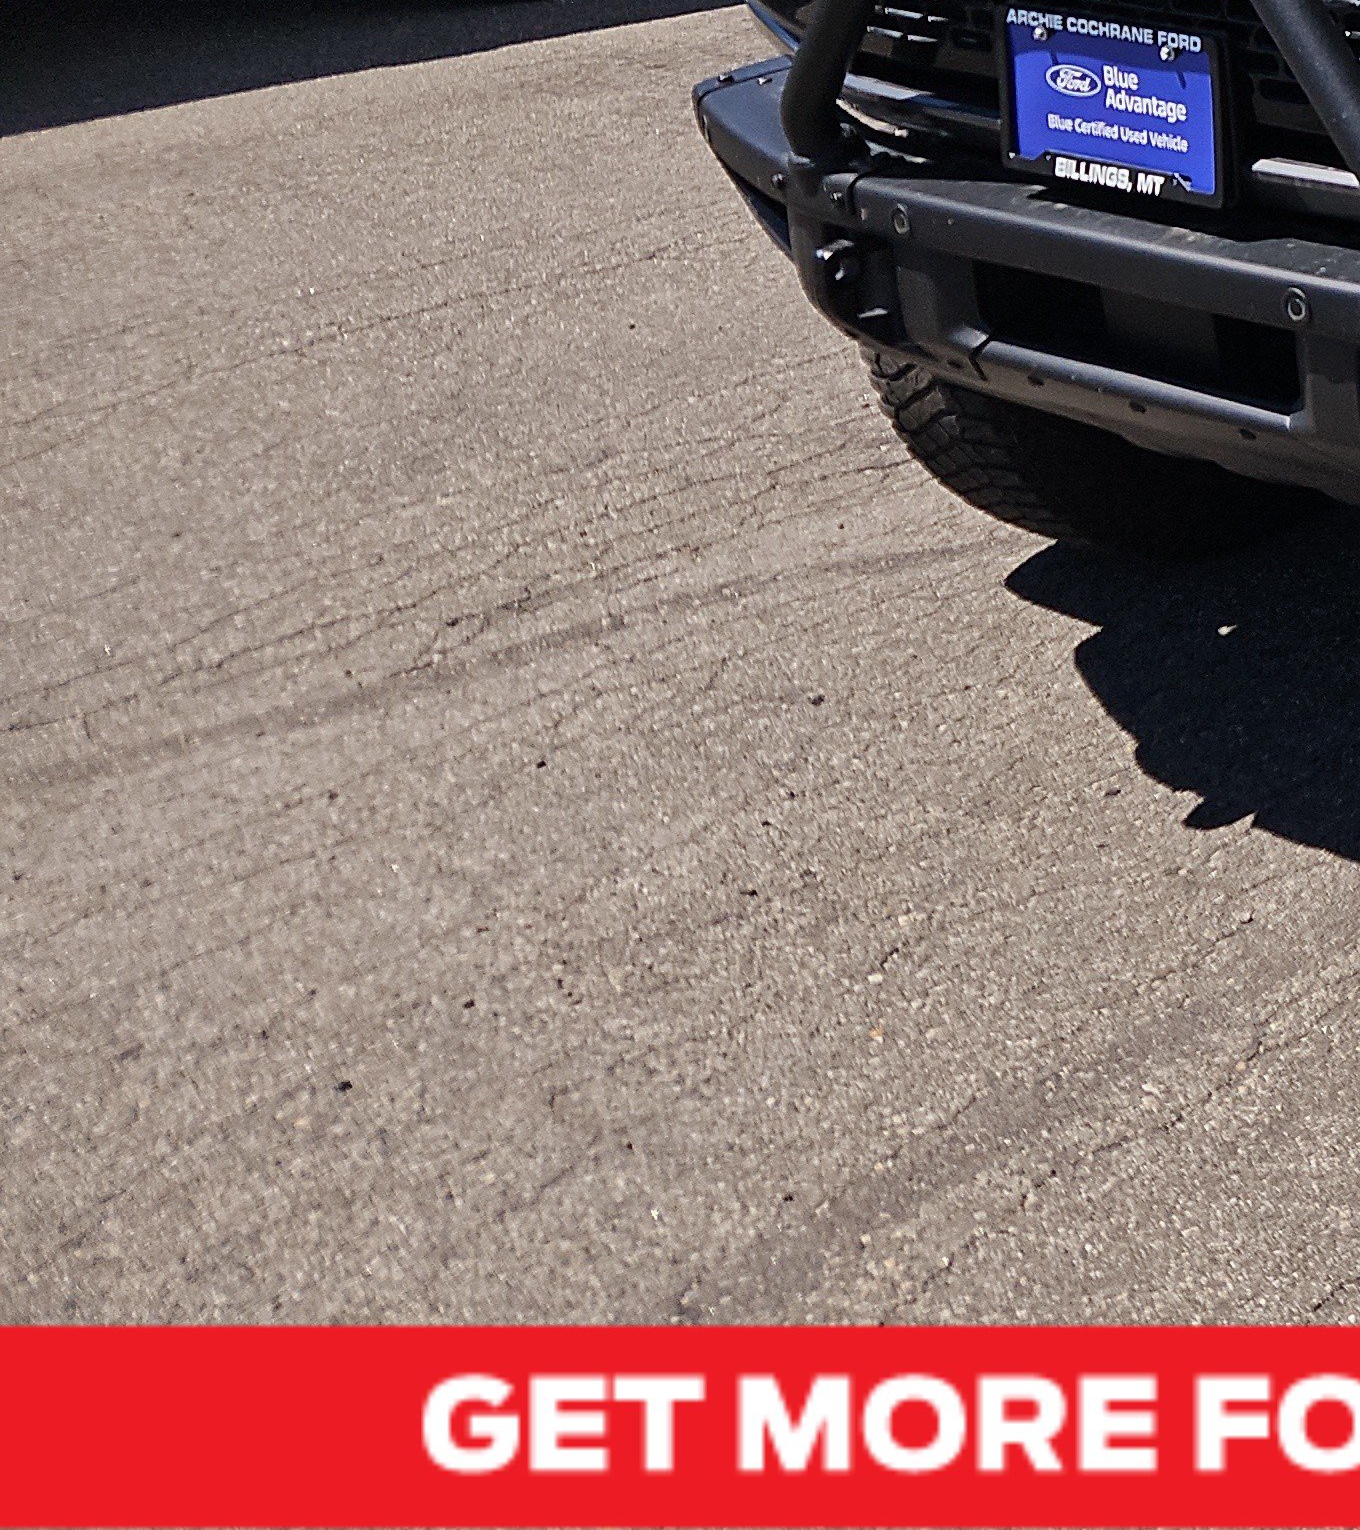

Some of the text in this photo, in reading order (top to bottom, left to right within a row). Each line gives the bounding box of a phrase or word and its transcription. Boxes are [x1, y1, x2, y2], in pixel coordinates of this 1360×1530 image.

[1006, 8, 1202, 53] ARCHIE COCHRANE FORD
[1056, 66, 1092, 92] Ford
[1103, 64, 1139, 91] Blue
[1105, 87, 1188, 124] Advantage
[1047, 113, 1189, 154] Blue Certified Used Vehicle
[1054, 156, 1166, 197] BILLINGS, MT
